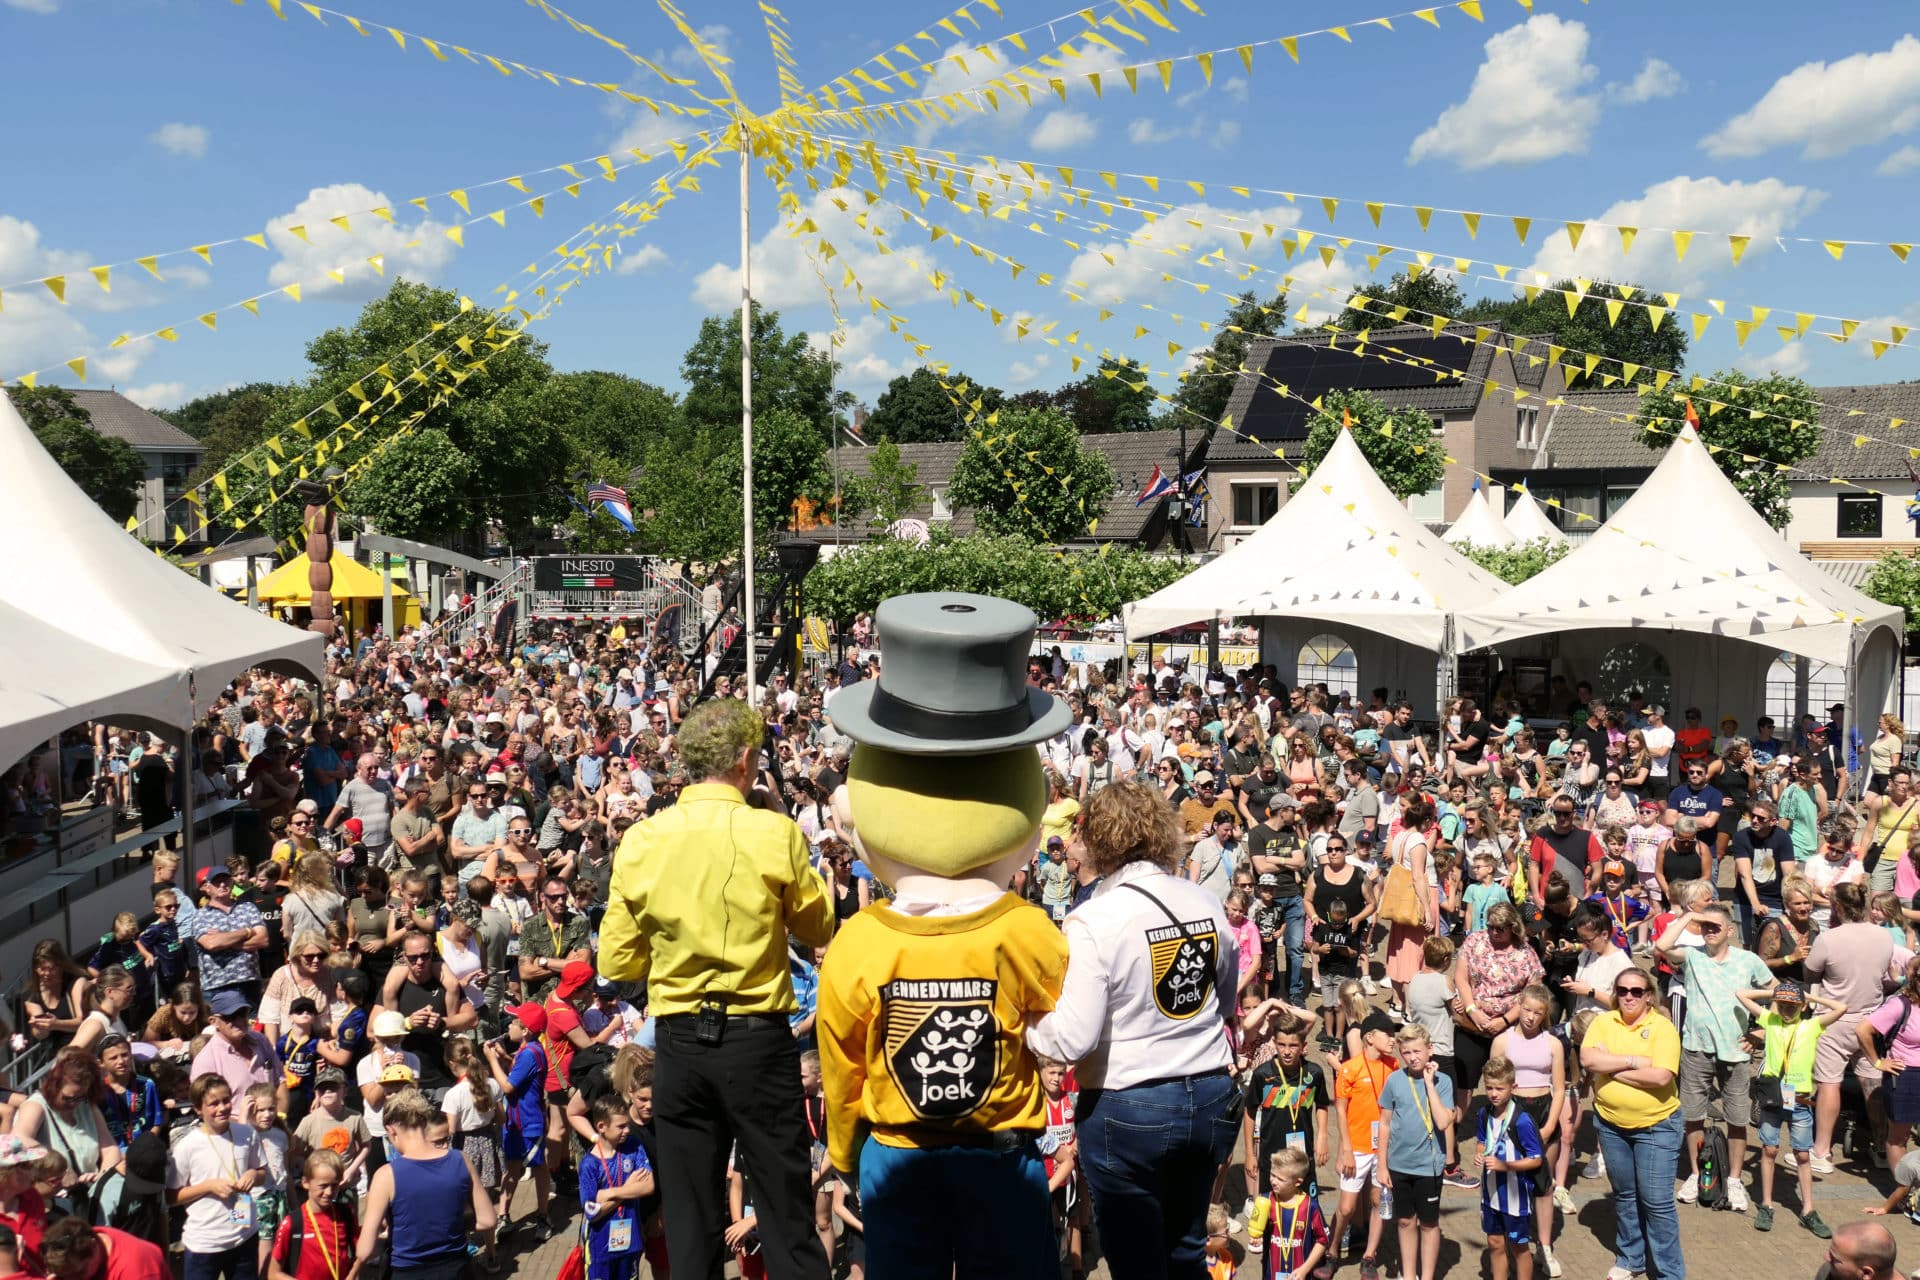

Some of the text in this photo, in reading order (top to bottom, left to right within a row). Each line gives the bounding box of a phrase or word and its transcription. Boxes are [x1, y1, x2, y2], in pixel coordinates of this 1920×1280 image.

[1147, 920, 1213, 943] KENNEDMARS
[1172, 989, 1201, 1010] joek
[919, 1078, 976, 1106] joek
[1309, 1181, 1317, 1197] 6
